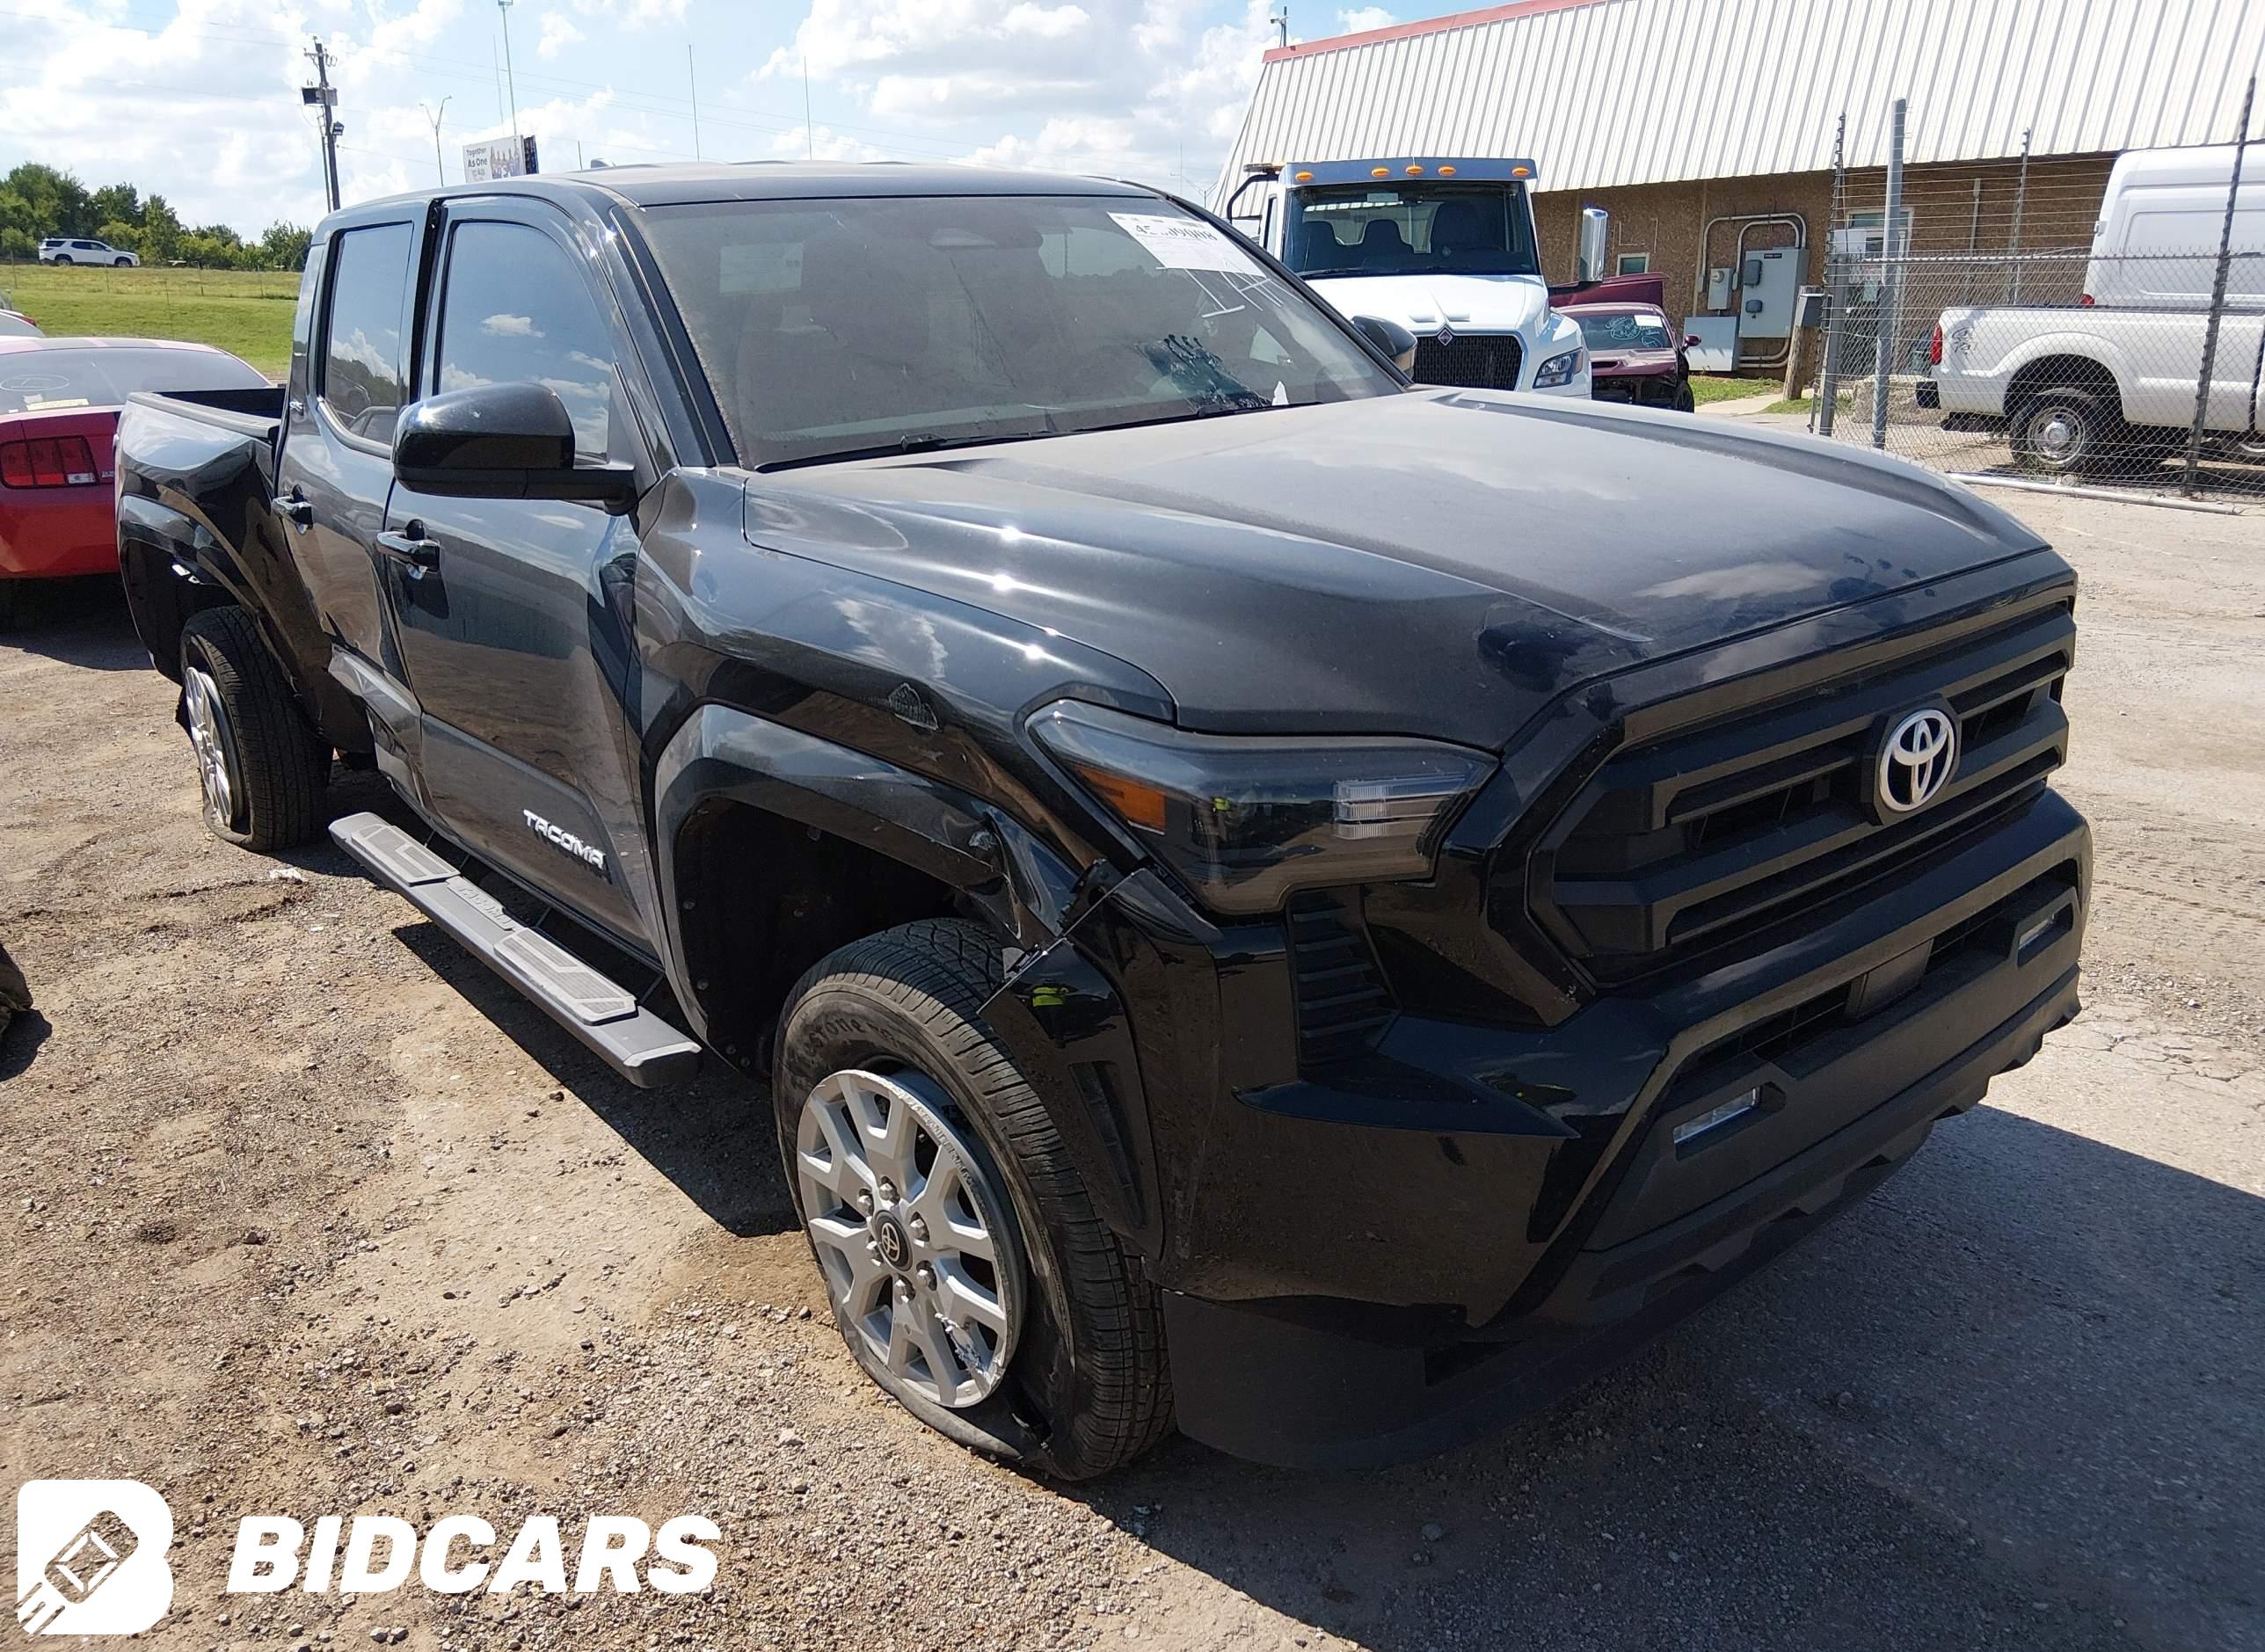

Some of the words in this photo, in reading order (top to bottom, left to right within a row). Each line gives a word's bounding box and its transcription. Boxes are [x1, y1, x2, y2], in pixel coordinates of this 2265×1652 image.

[466, 148, 486, 156] Together
[476, 157, 488, 166] One
[523, 809, 607, 869] TACOMA
